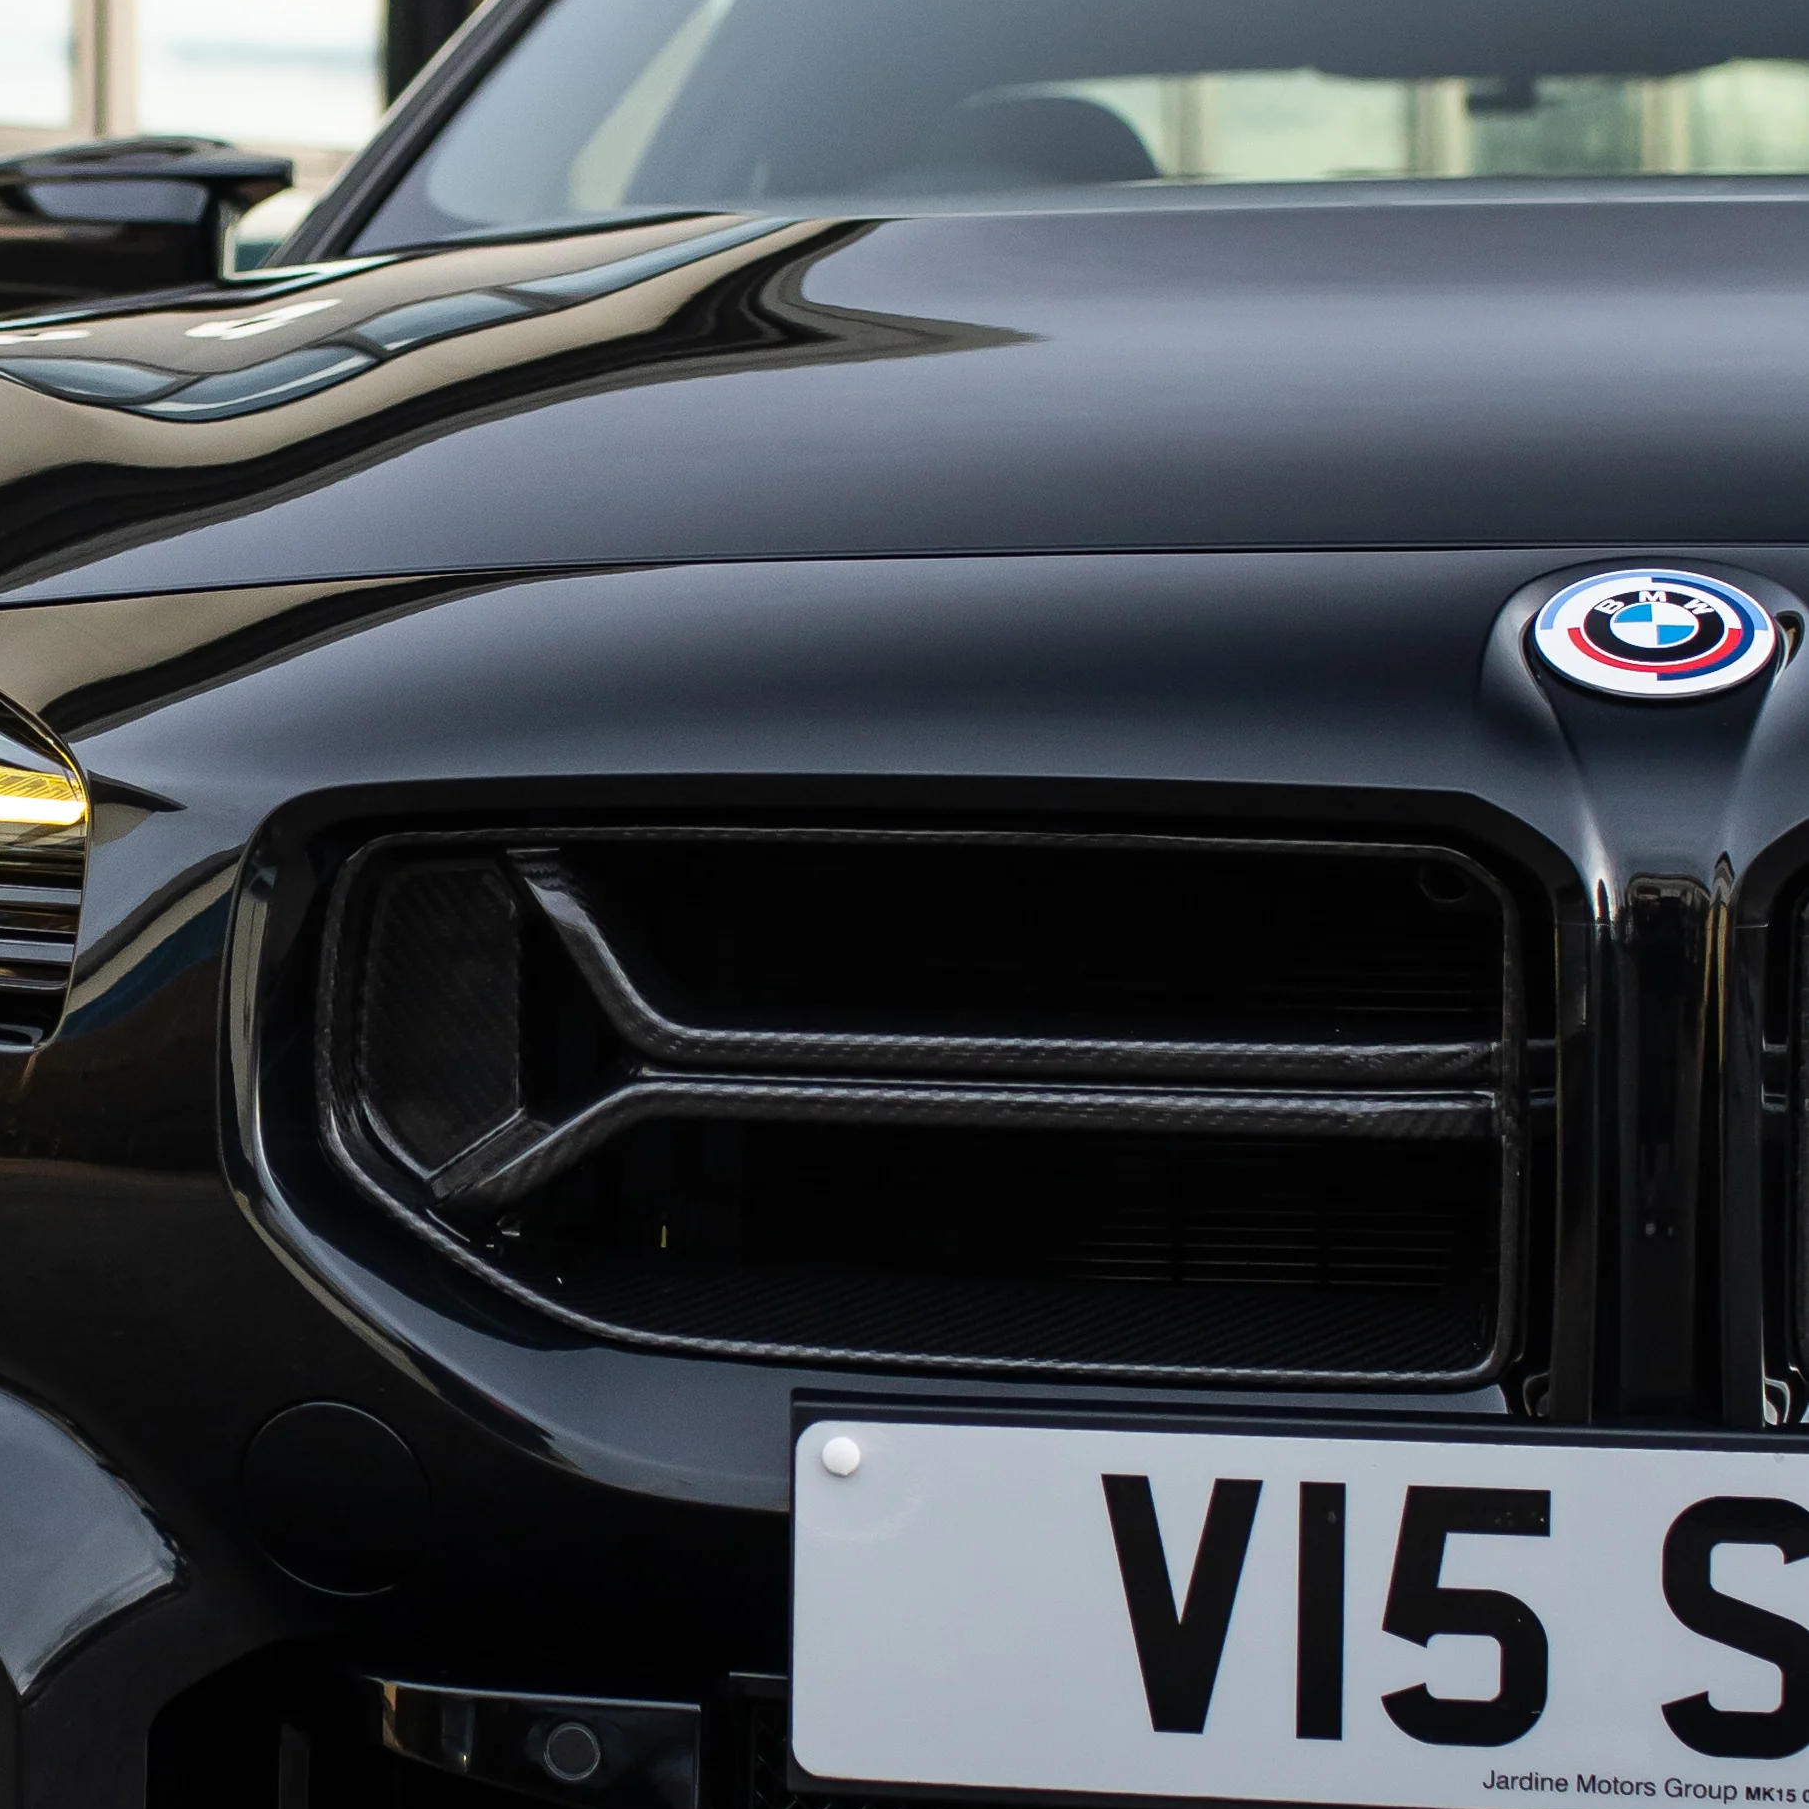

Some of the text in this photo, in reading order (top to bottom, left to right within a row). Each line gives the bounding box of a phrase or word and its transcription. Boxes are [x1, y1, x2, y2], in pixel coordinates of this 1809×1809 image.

[1594, 589, 1715, 615] BMW
[1660, 1495, 1809, 1760] S
[1482, 1770, 1569, 1793] Jardine
[1576, 1774, 1657, 1797] Motors
[1664, 1778, 1738, 1805] Group
[1745, 1786, 1797, 1803] MK15
